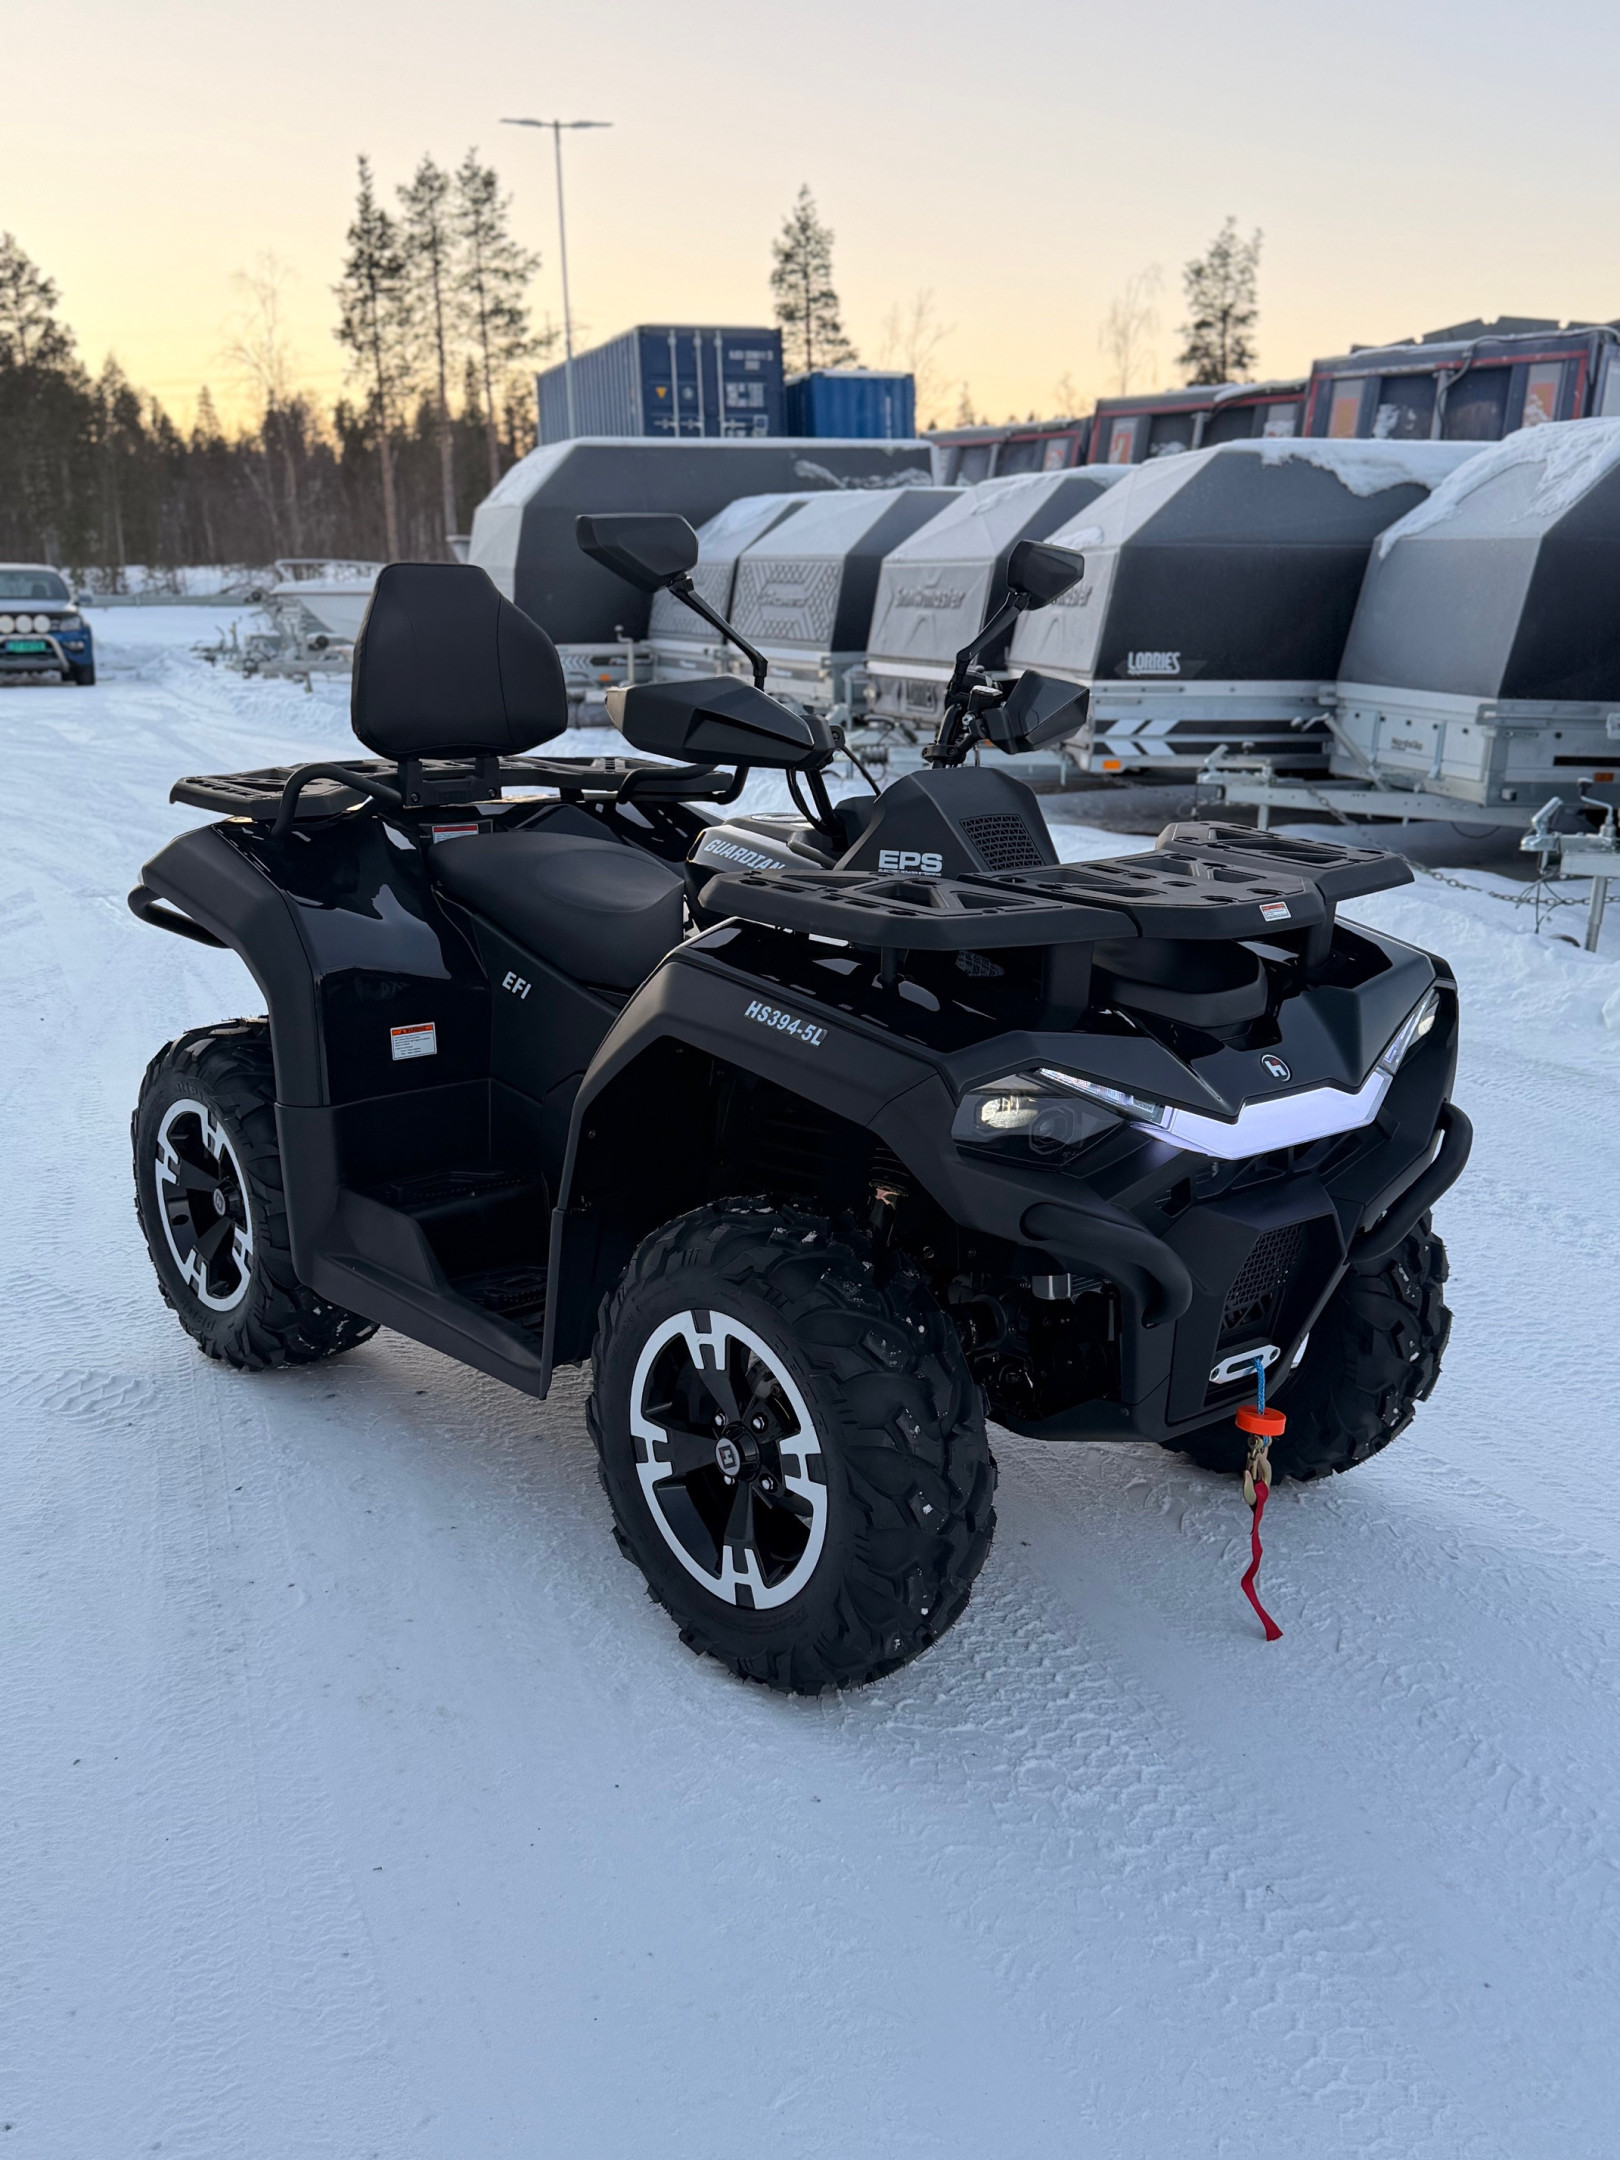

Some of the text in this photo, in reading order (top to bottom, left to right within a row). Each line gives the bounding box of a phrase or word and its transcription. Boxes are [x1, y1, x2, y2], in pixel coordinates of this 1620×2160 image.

[1127, 651, 1181, 675] LORRIES
[878, 849, 943, 873] EPS
[502, 971, 532, 1000] EFI
[744, 1000, 822, 1046] HS394-5L
